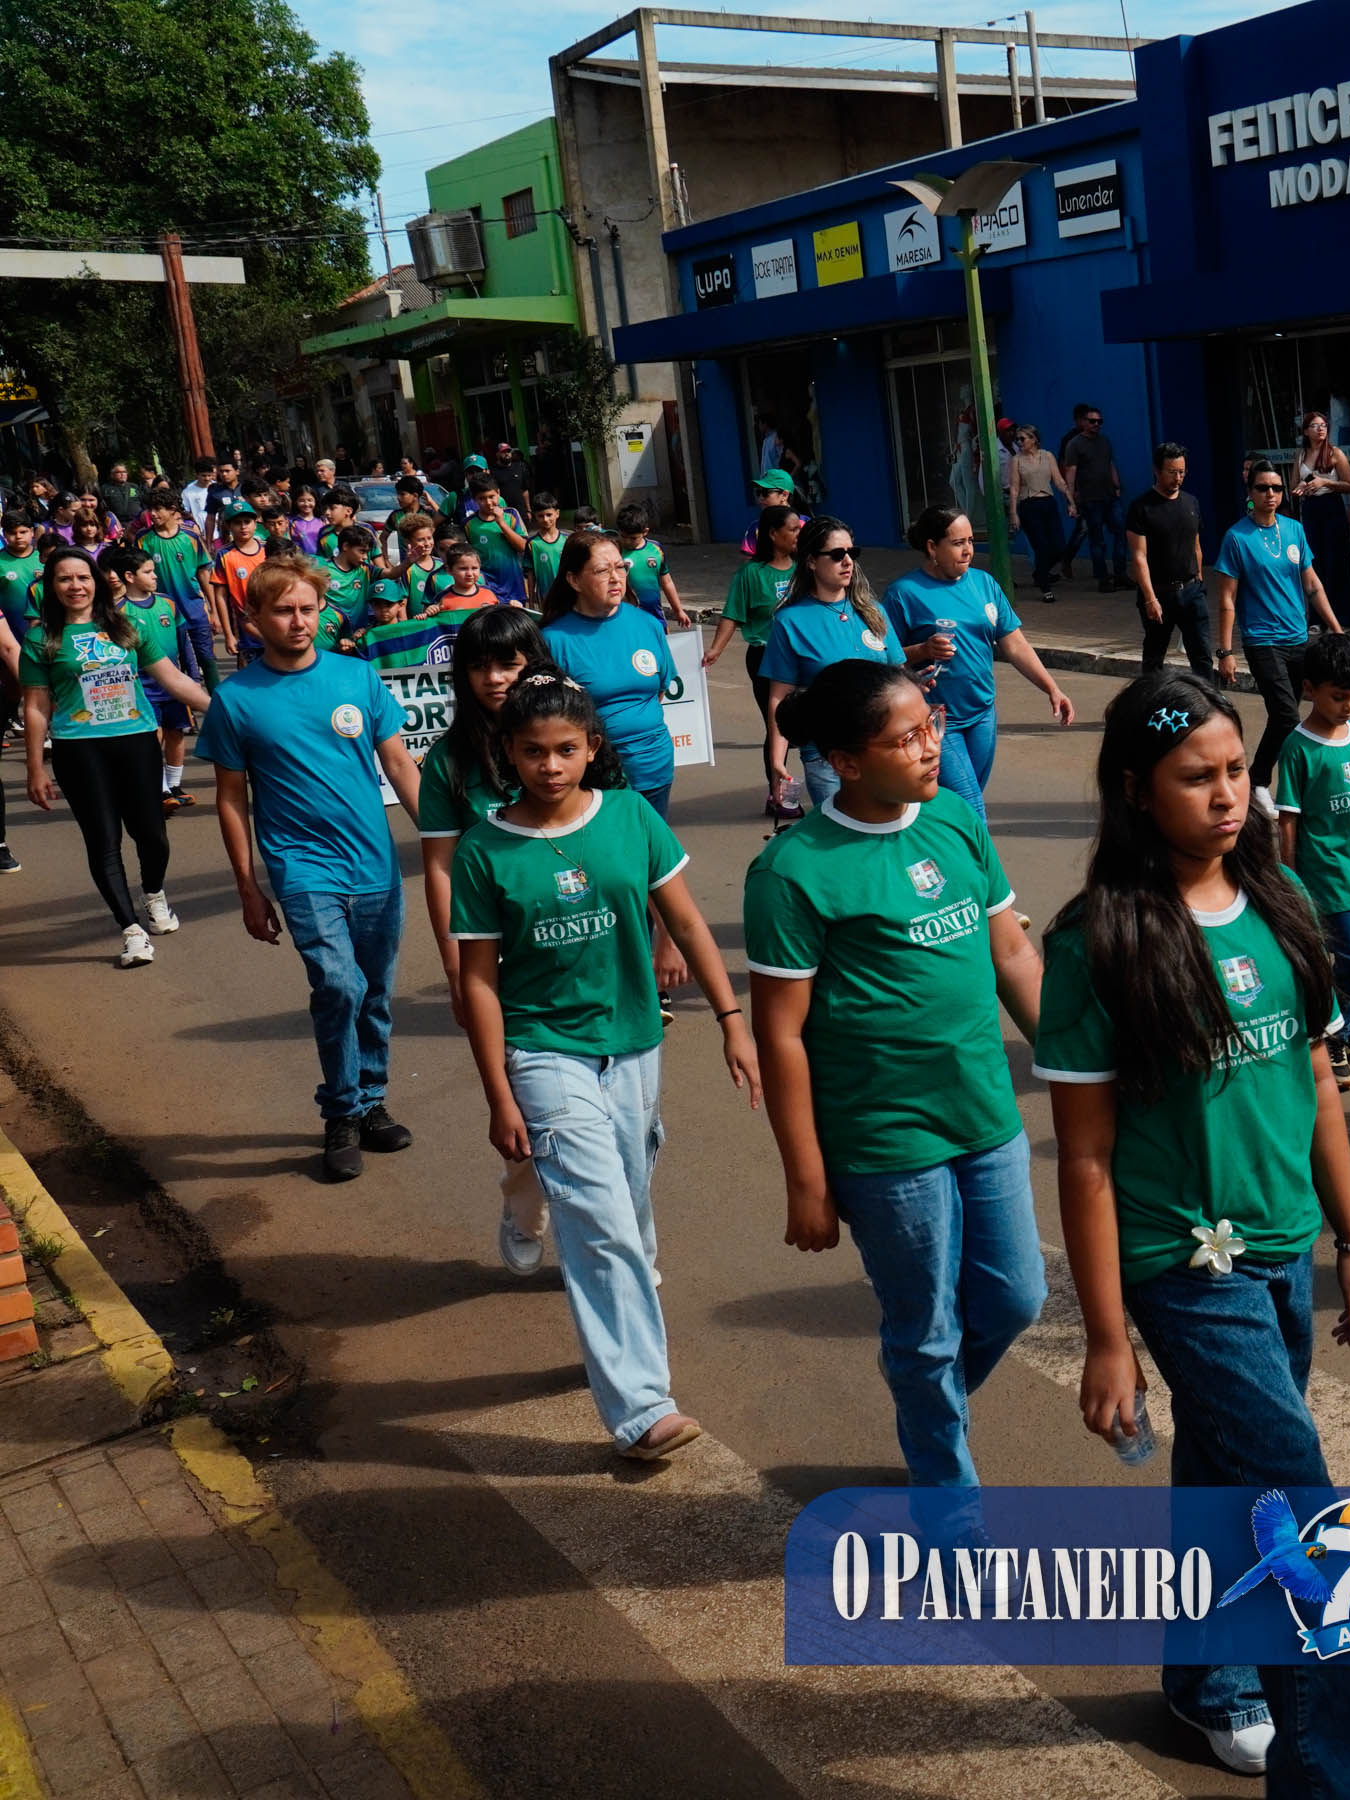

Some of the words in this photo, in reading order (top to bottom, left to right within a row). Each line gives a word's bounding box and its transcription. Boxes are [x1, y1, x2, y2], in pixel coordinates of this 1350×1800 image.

[1058, 186, 1114, 215] Lunender
[816, 252, 833, 263] MAX
[835, 244, 859, 259] DENIM
[896, 247, 932, 266] MARESIA
[695, 267, 732, 299] LUPO
[533, 911, 617, 942] BONITO
[908, 902, 980, 943] BONITO
